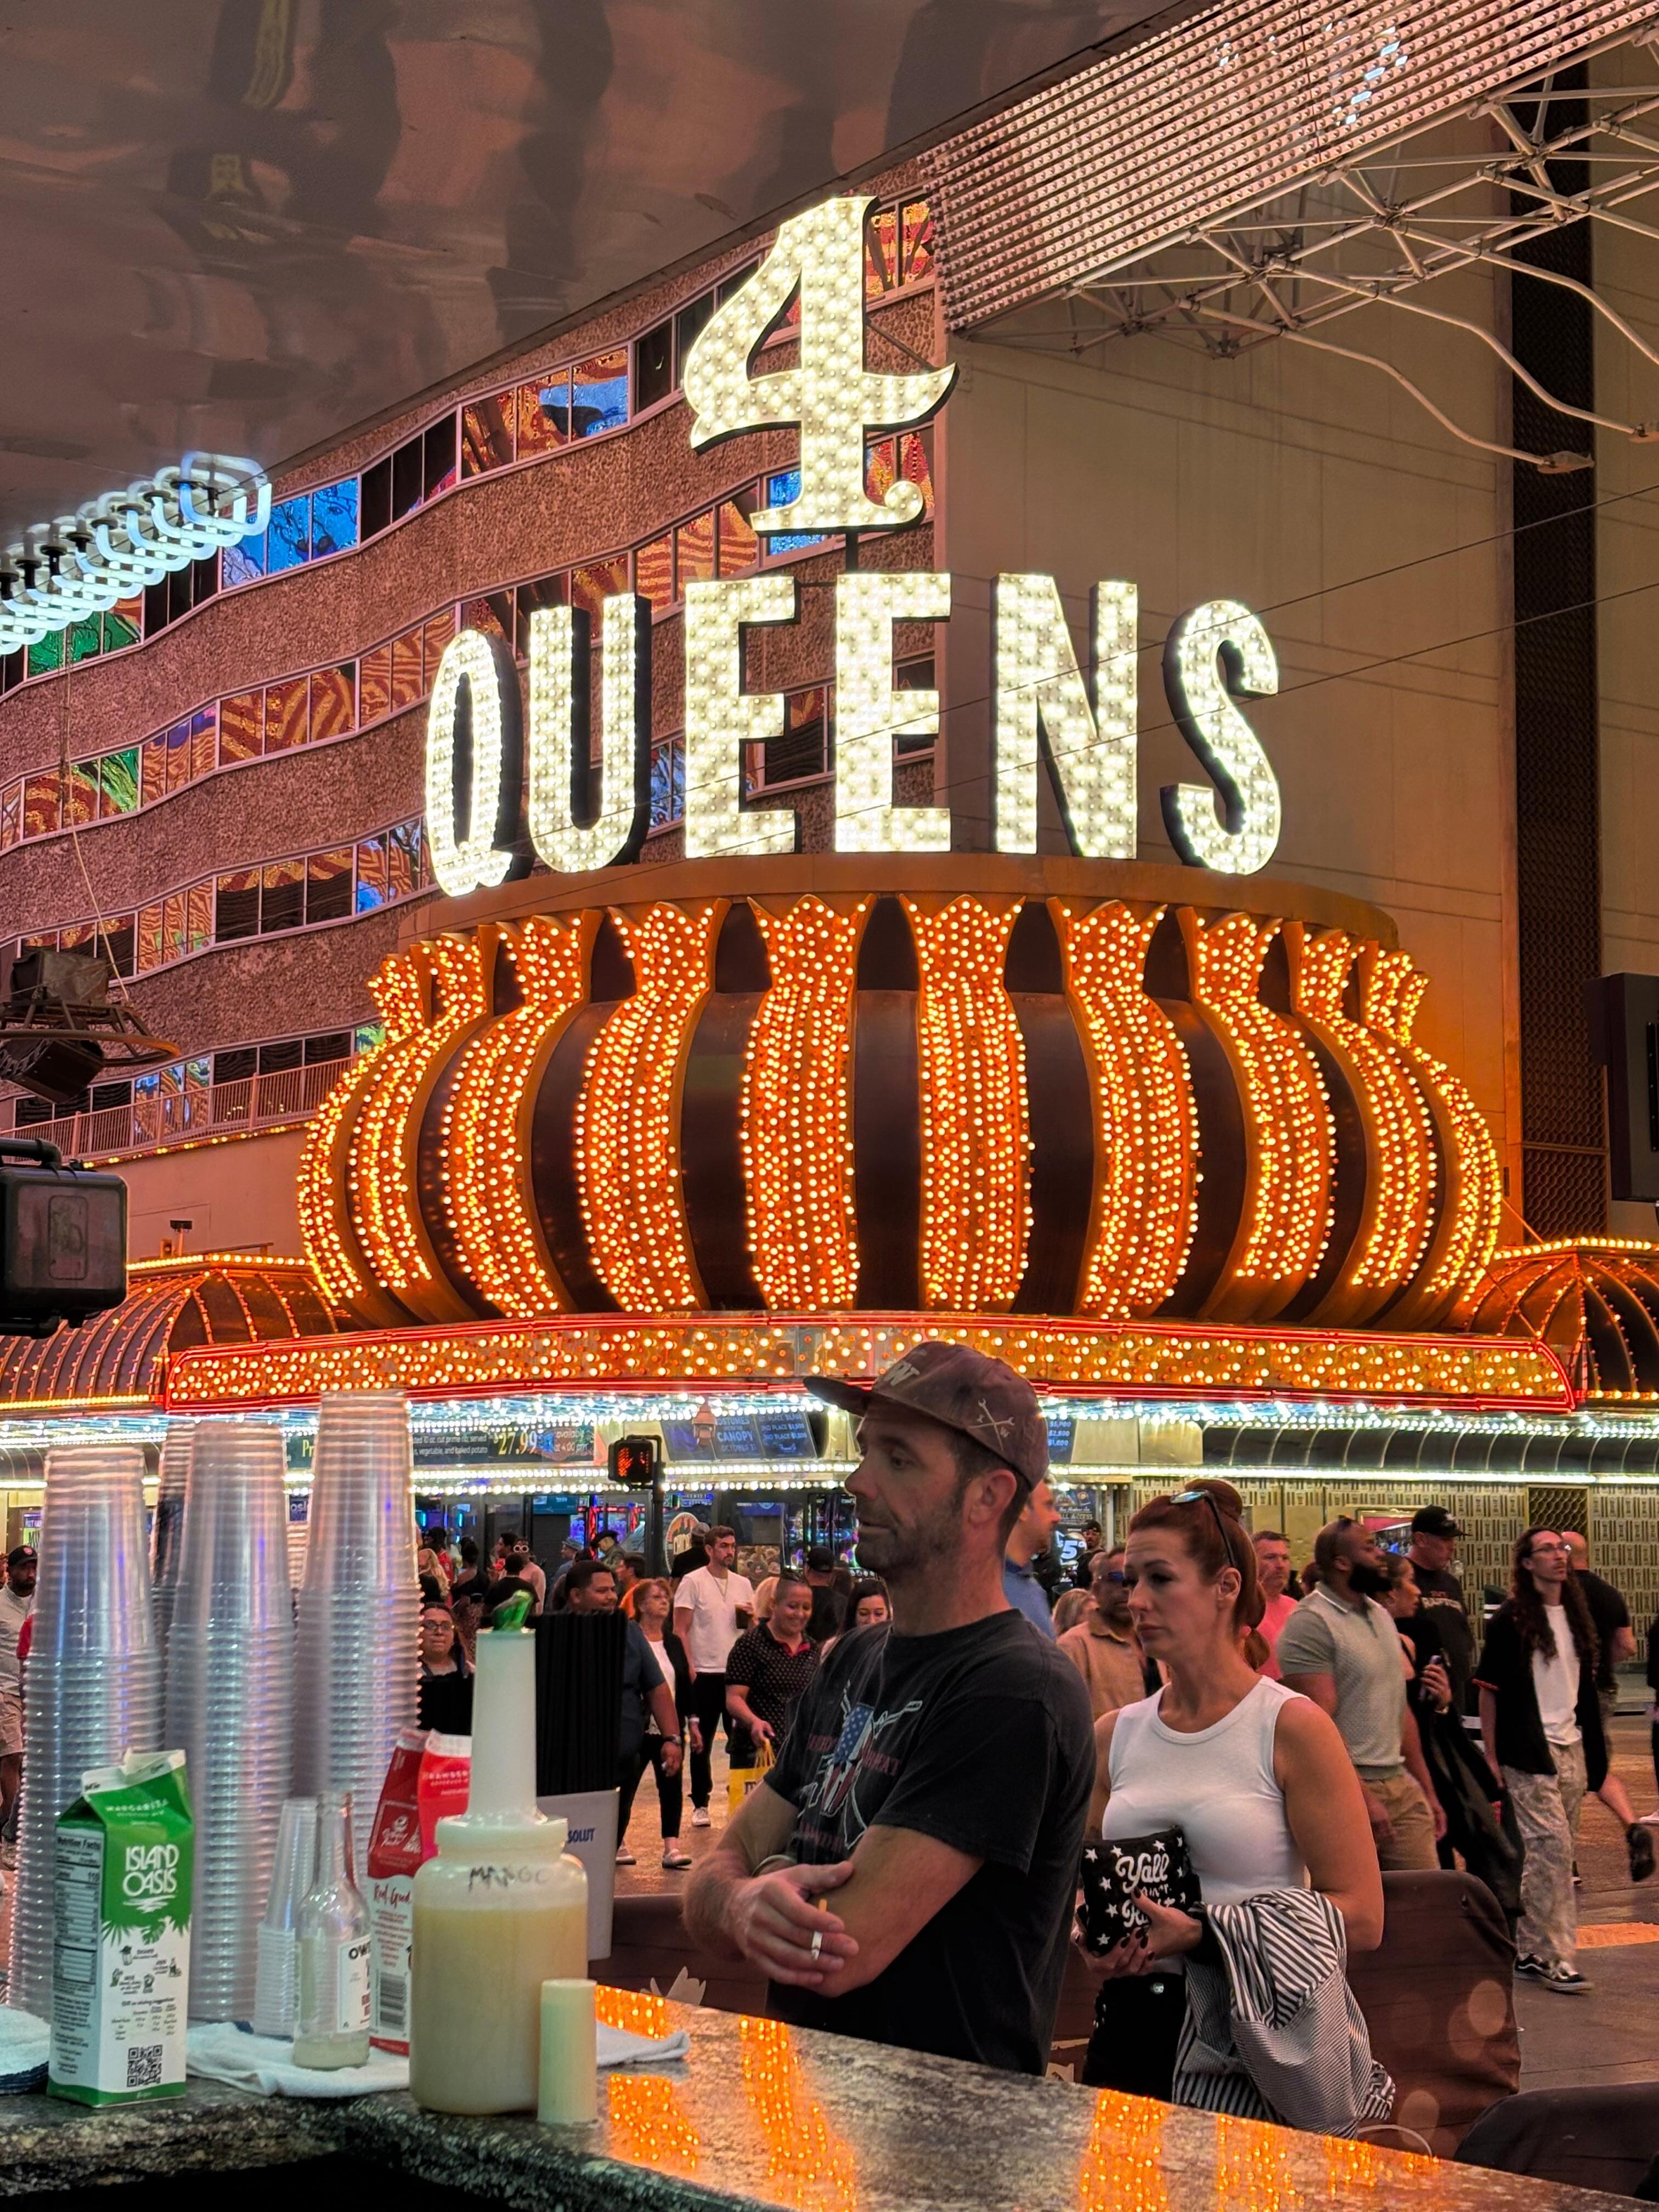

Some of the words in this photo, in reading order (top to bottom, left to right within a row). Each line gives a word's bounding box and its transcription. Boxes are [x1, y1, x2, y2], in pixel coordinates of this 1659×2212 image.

[684, 195, 958, 533] 4
[424, 572, 1282, 898] QUEENS
[717, 1417, 750, 1426] OSTUMES
[446, 1436, 461, 1445] prime
[470, 1434, 487, 1442] served
[717, 1430, 753, 1442] CANOPY
[444, 1446, 455, 1454] and
[568, 1828, 596, 1844] SOLUT
[125, 1843, 180, 1871] ISLAND
[123, 1868, 177, 1897] OASIS
